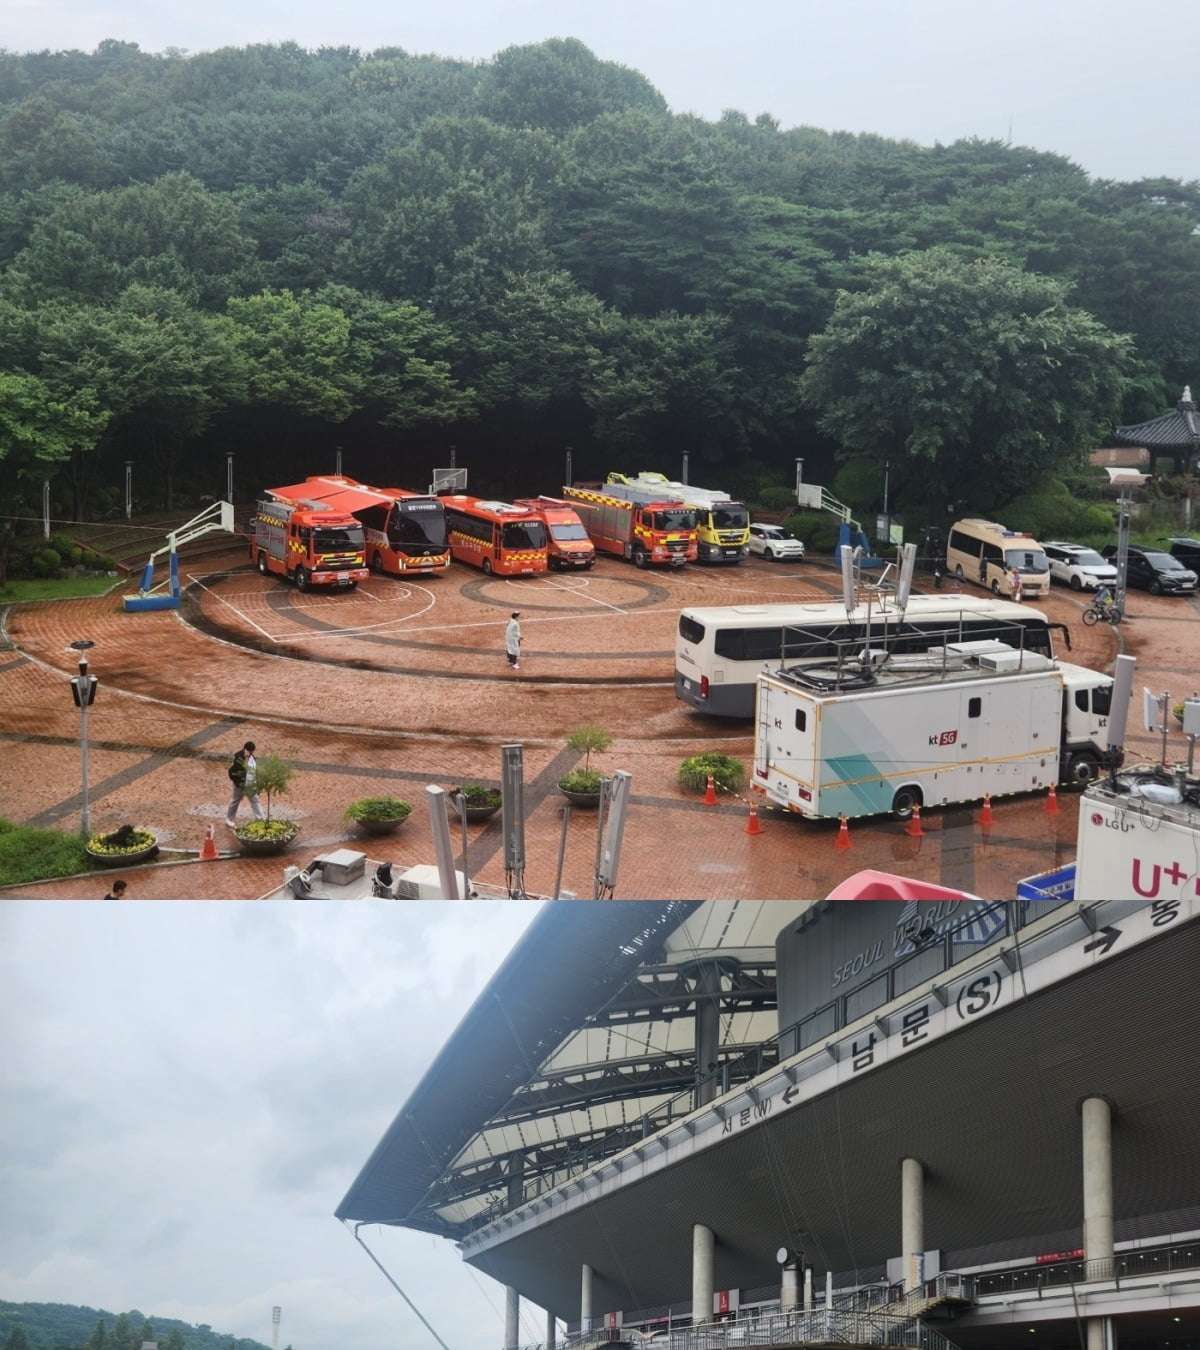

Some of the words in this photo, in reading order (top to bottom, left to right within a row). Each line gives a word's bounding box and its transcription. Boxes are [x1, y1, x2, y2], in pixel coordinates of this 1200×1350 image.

[775, 717, 783, 729] kt
[1098, 717, 1107, 728] kt
[928, 735, 938, 746] kt
[941, 732, 956, 745] 5G
[1132, 858, 1188, 898] U+
[832, 939, 885, 988] SEOUL
